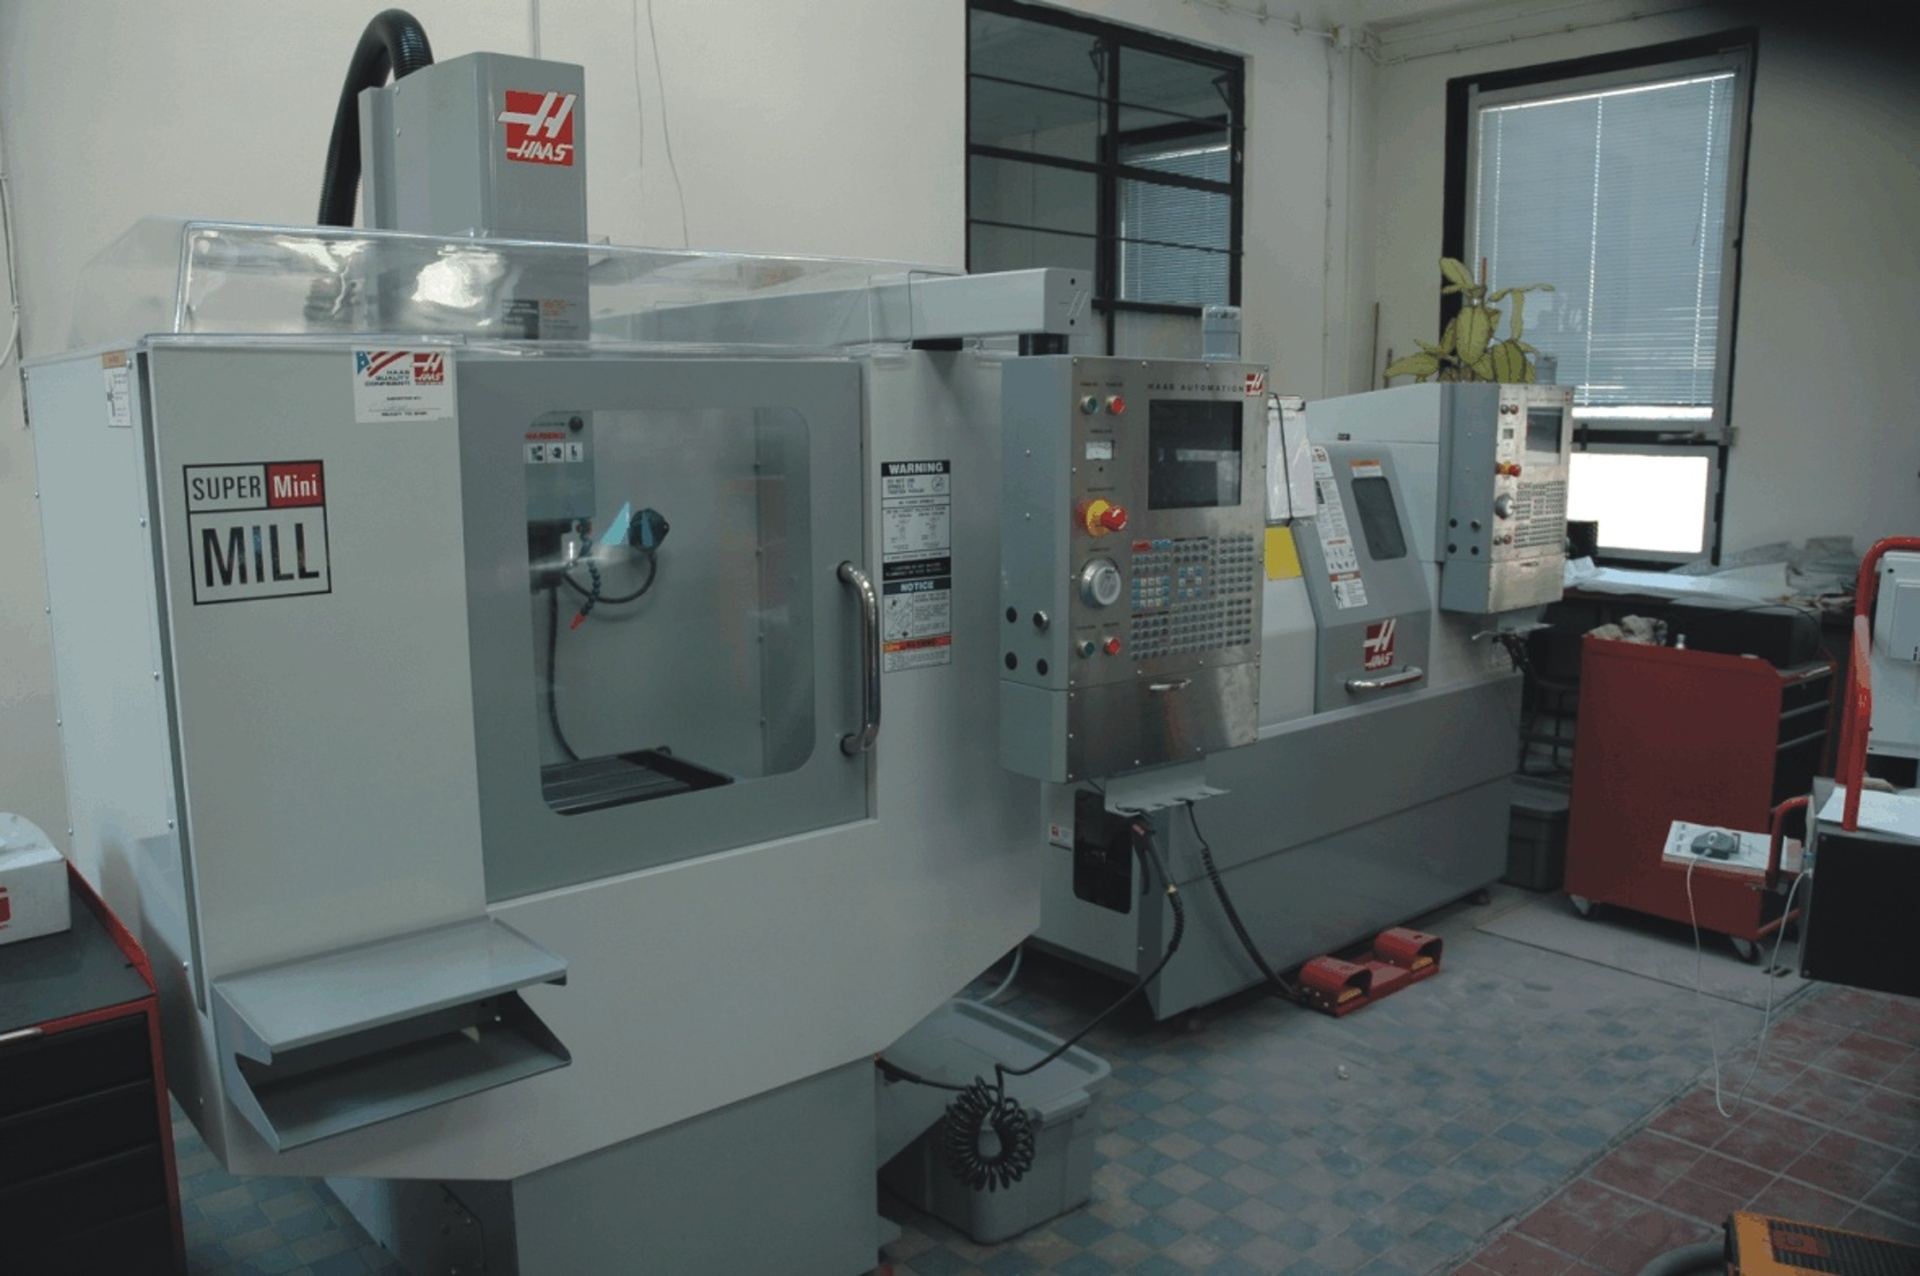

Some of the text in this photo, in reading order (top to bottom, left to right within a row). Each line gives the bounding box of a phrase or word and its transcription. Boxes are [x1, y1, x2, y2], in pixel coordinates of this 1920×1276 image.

[507, 140, 573, 162] HAAS
[1147, 383, 1175, 391] HAAS
[1180, 384, 1244, 393] AUTOMATION
[888, 462, 944, 475] WARNING
[192, 473, 318, 501] SUPER Mini
[201, 522, 320, 588] MILL
[900, 581, 935, 592] NOTICE
